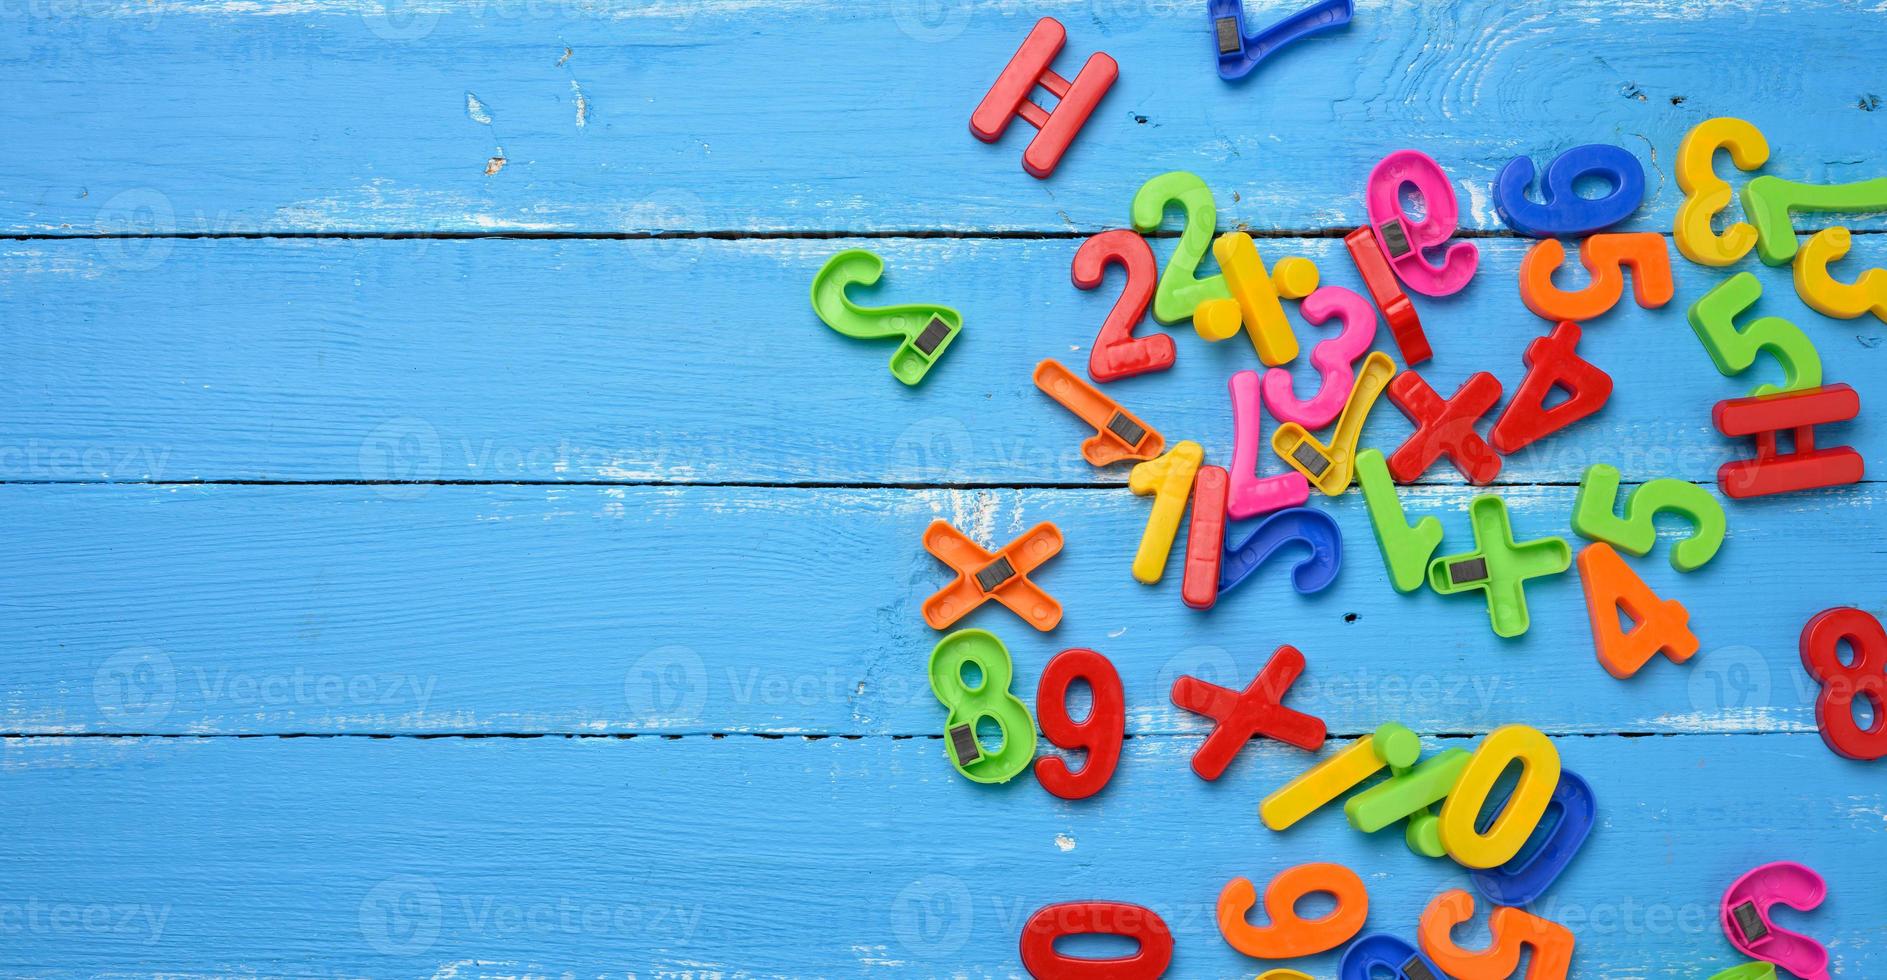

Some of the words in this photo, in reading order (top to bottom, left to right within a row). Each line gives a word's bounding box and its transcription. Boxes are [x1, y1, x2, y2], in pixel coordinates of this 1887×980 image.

[1072, 229, 1176, 383] 2
[1132, 171, 1228, 325] 2
[1519, 232, 1674, 320] 5
[1261, 286, 1377, 430] 3
[1488, 320, 1613, 455] 4
[1688, 271, 1823, 398] 5
[1129, 440, 1204, 585] 1
[1571, 464, 1727, 573] 5
[1577, 542, 1700, 679] 4
[929, 629, 1037, 784] 8
[1034, 648, 1125, 800] 9
[1799, 606, 1887, 760] 8
[1440, 725, 1561, 869] 0
[1019, 900, 1175, 980] 0
[1418, 889, 1575, 980] 5
